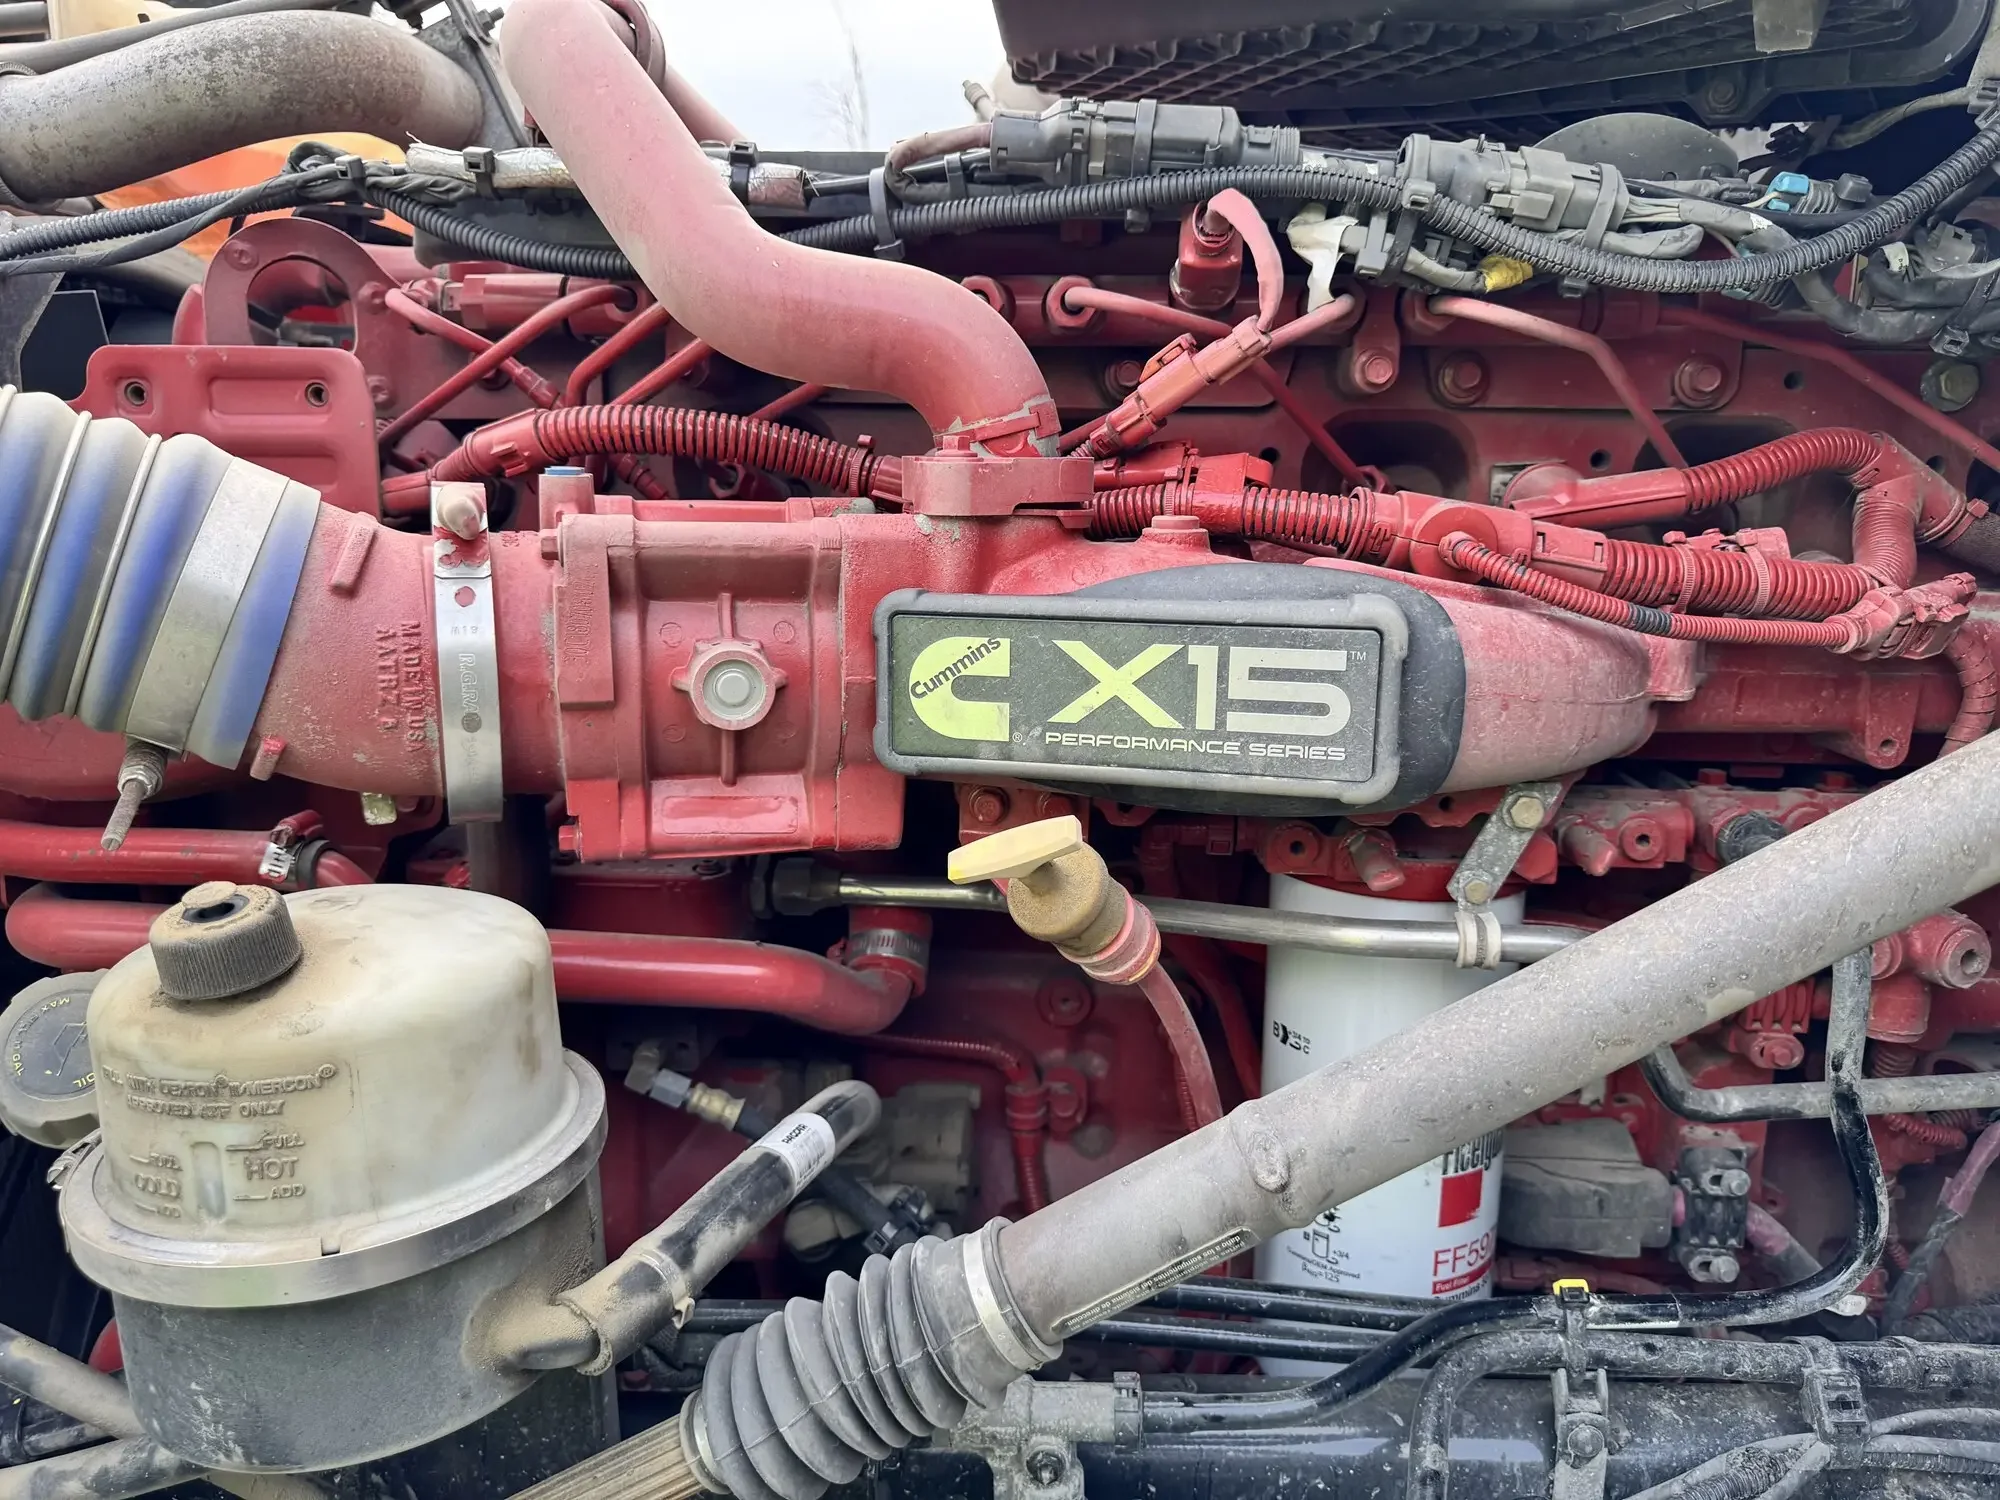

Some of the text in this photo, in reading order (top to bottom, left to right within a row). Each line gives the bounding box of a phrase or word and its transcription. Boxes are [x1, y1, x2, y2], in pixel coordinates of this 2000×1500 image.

[400, 621, 422, 683] MADE
[910, 634, 1002, 699] Cummins
[1046, 639, 1353, 737] X15
[406, 714, 426, 753] USA
[1045, 731, 1347, 761] PERFORMANCE SERIES
[41, 996, 71, 1014] MAX
[127, 1094, 194, 1119] APPROVED
[239, 1099, 286, 1118] ONLY
[260, 1131, 305, 1150] FULL
[244, 1156, 300, 1181] HOT
[270, 1183, 306, 1200] ADD
